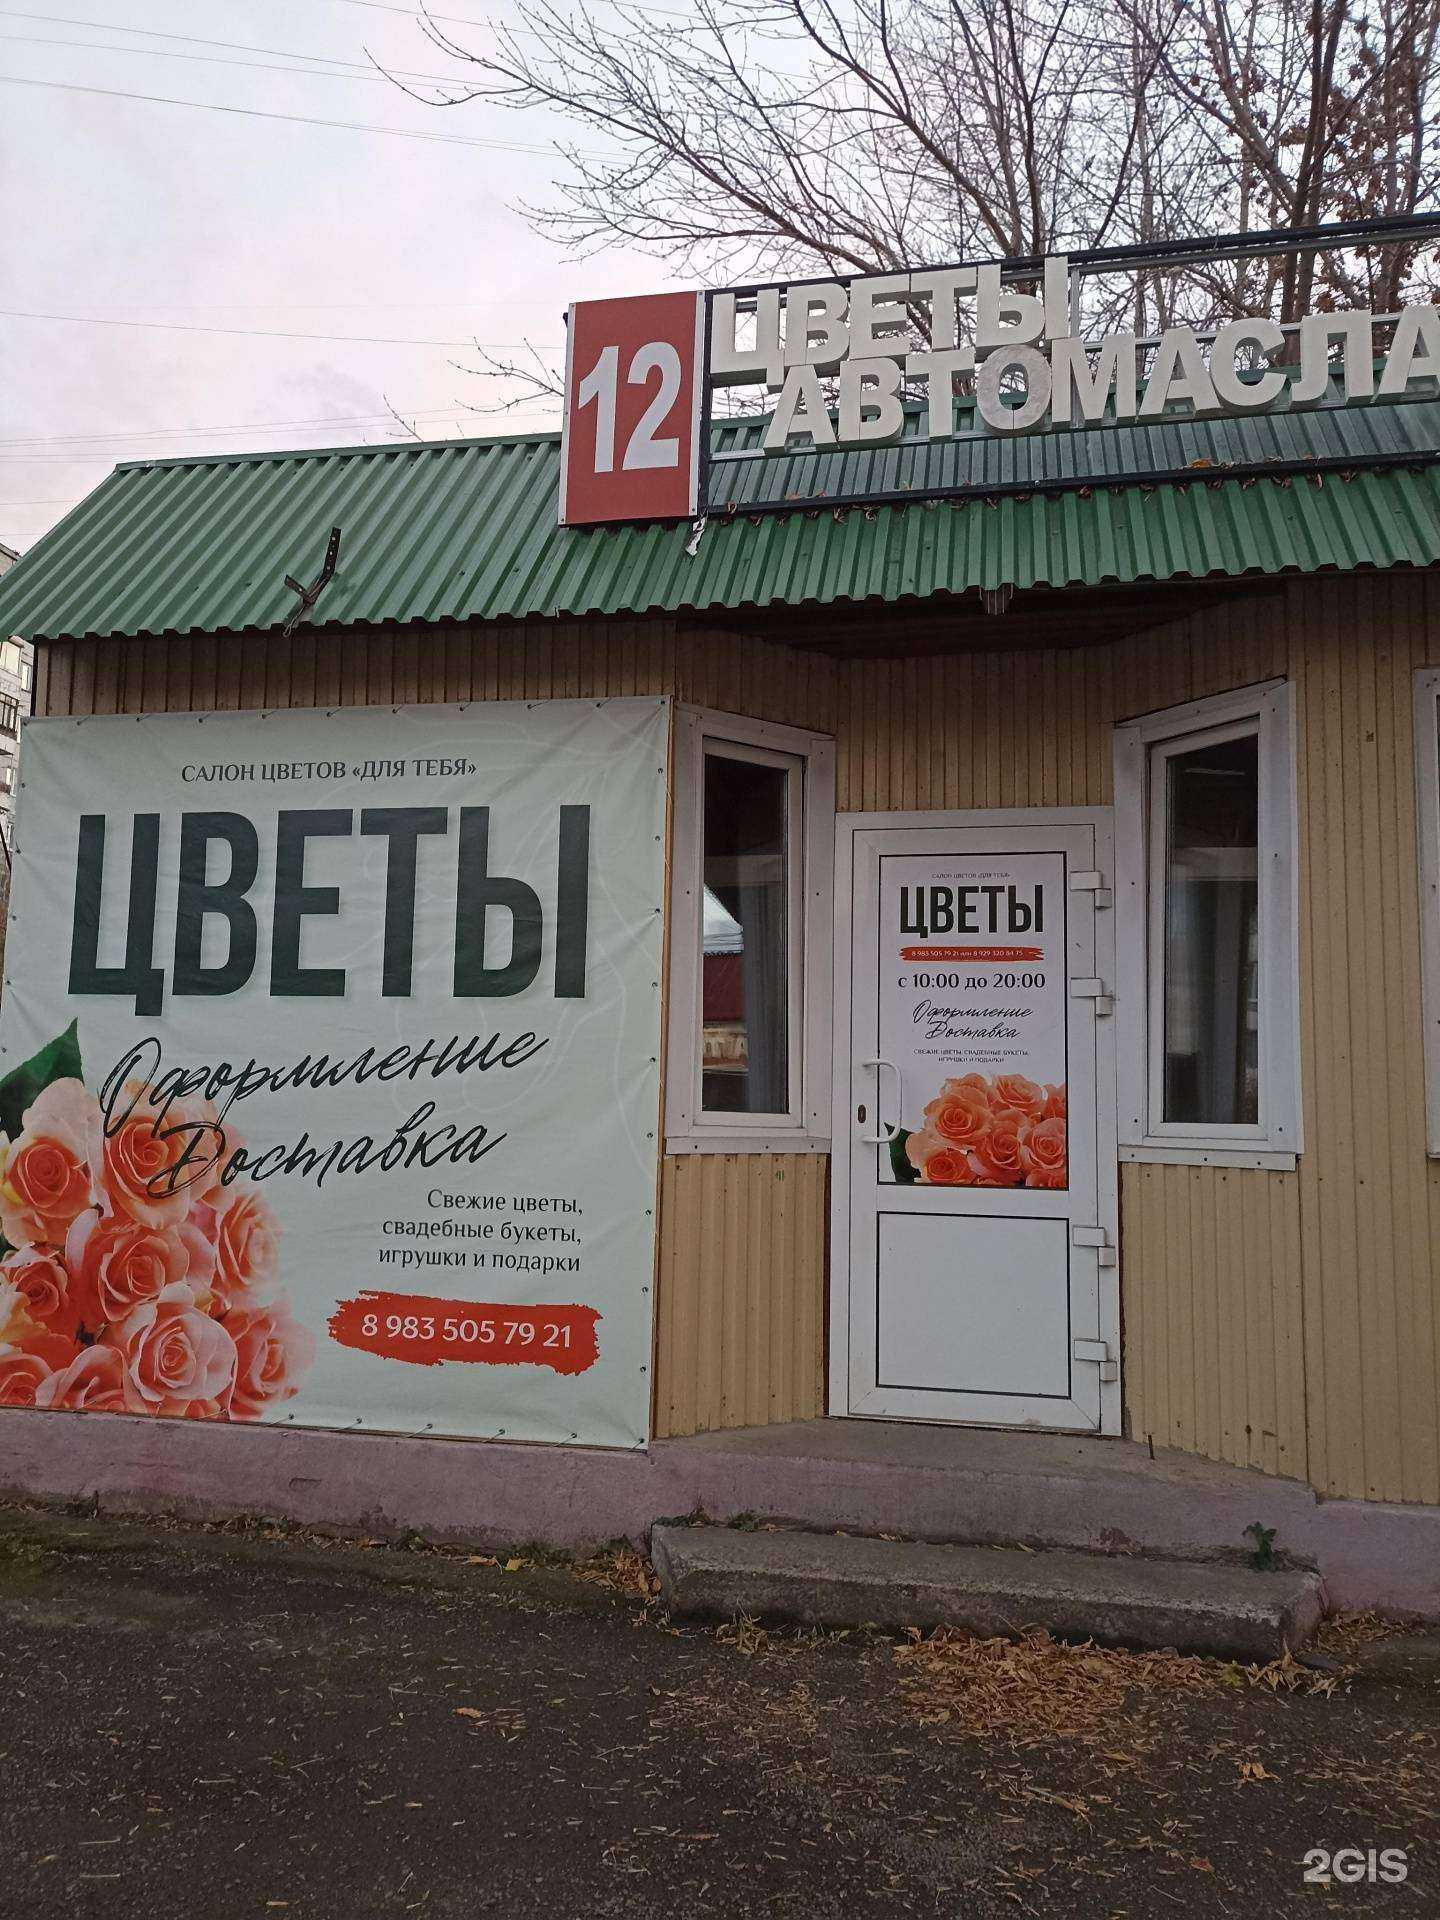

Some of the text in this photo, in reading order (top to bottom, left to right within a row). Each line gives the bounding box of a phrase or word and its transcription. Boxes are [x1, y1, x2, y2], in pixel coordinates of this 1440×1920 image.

[711, 256, 1071, 393] ЦВЕТЫ
[763, 304, 1440, 454] АВТОМАСЛА
[578, 341, 682, 474] 12
[181, 758, 477, 783] САЛОН ЦВЕТОВ «ДЛЯ ТЕБЯ»
[67, 804, 591, 1016] ЦВЕТЫ
[900, 884, 1043, 938] ЦВЕТЫ
[897, 973, 1046, 990] с 10:00 до 20:00
[913, 1000, 1033, 1023] Оформление
[925, 1021, 1020, 1039] Доставка
[100, 1031, 549, 1138] Оформление
[147, 1101, 507, 1199] Доставка
[427, 1189, 583, 1216] Свежие цветы,
[382, 1219, 582, 1246] свадебные букеты,
[379, 1248, 580, 1274] игрушки и подарки
[361, 1314, 571, 1348] 8 983 505 79 21
